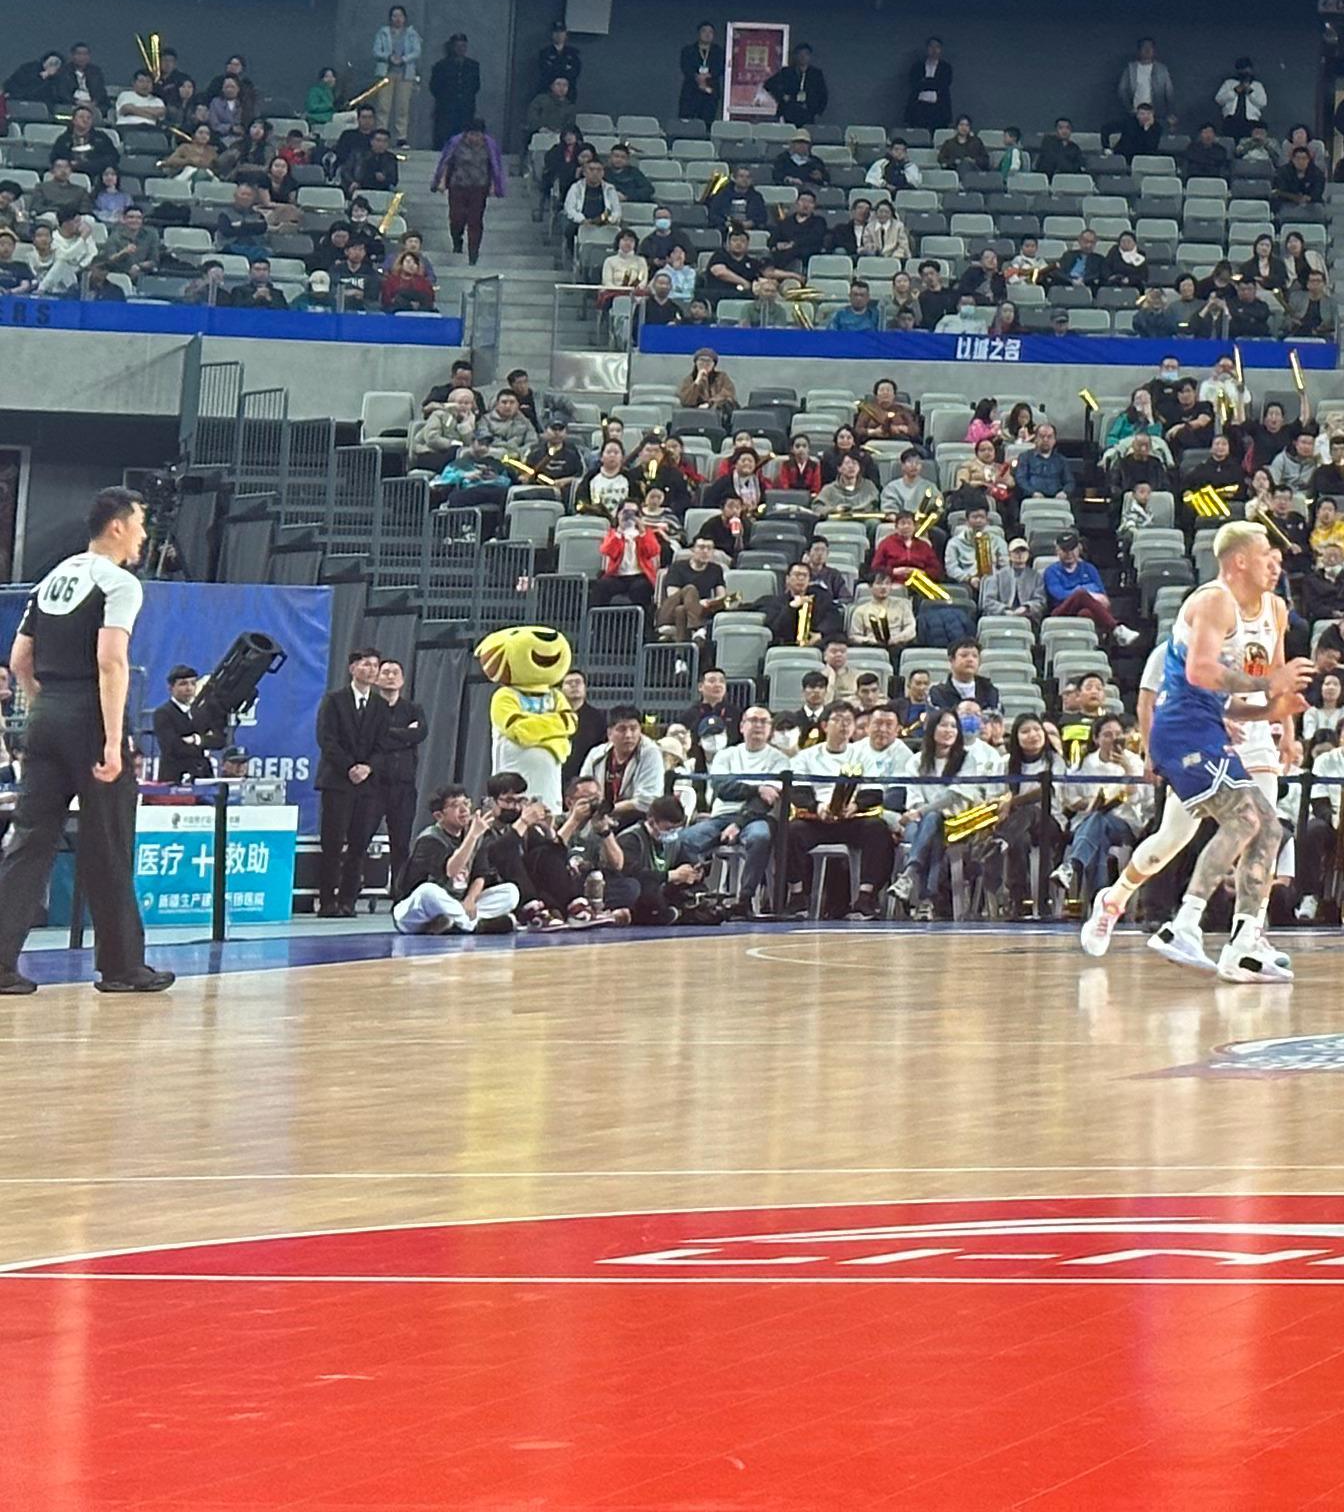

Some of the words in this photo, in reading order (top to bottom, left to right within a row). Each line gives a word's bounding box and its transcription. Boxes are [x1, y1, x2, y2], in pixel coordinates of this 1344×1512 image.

[956, 336, 1021, 361] 以城之名
[43, 576, 79, 603] 106
[137, 842, 185, 876] 医疗
